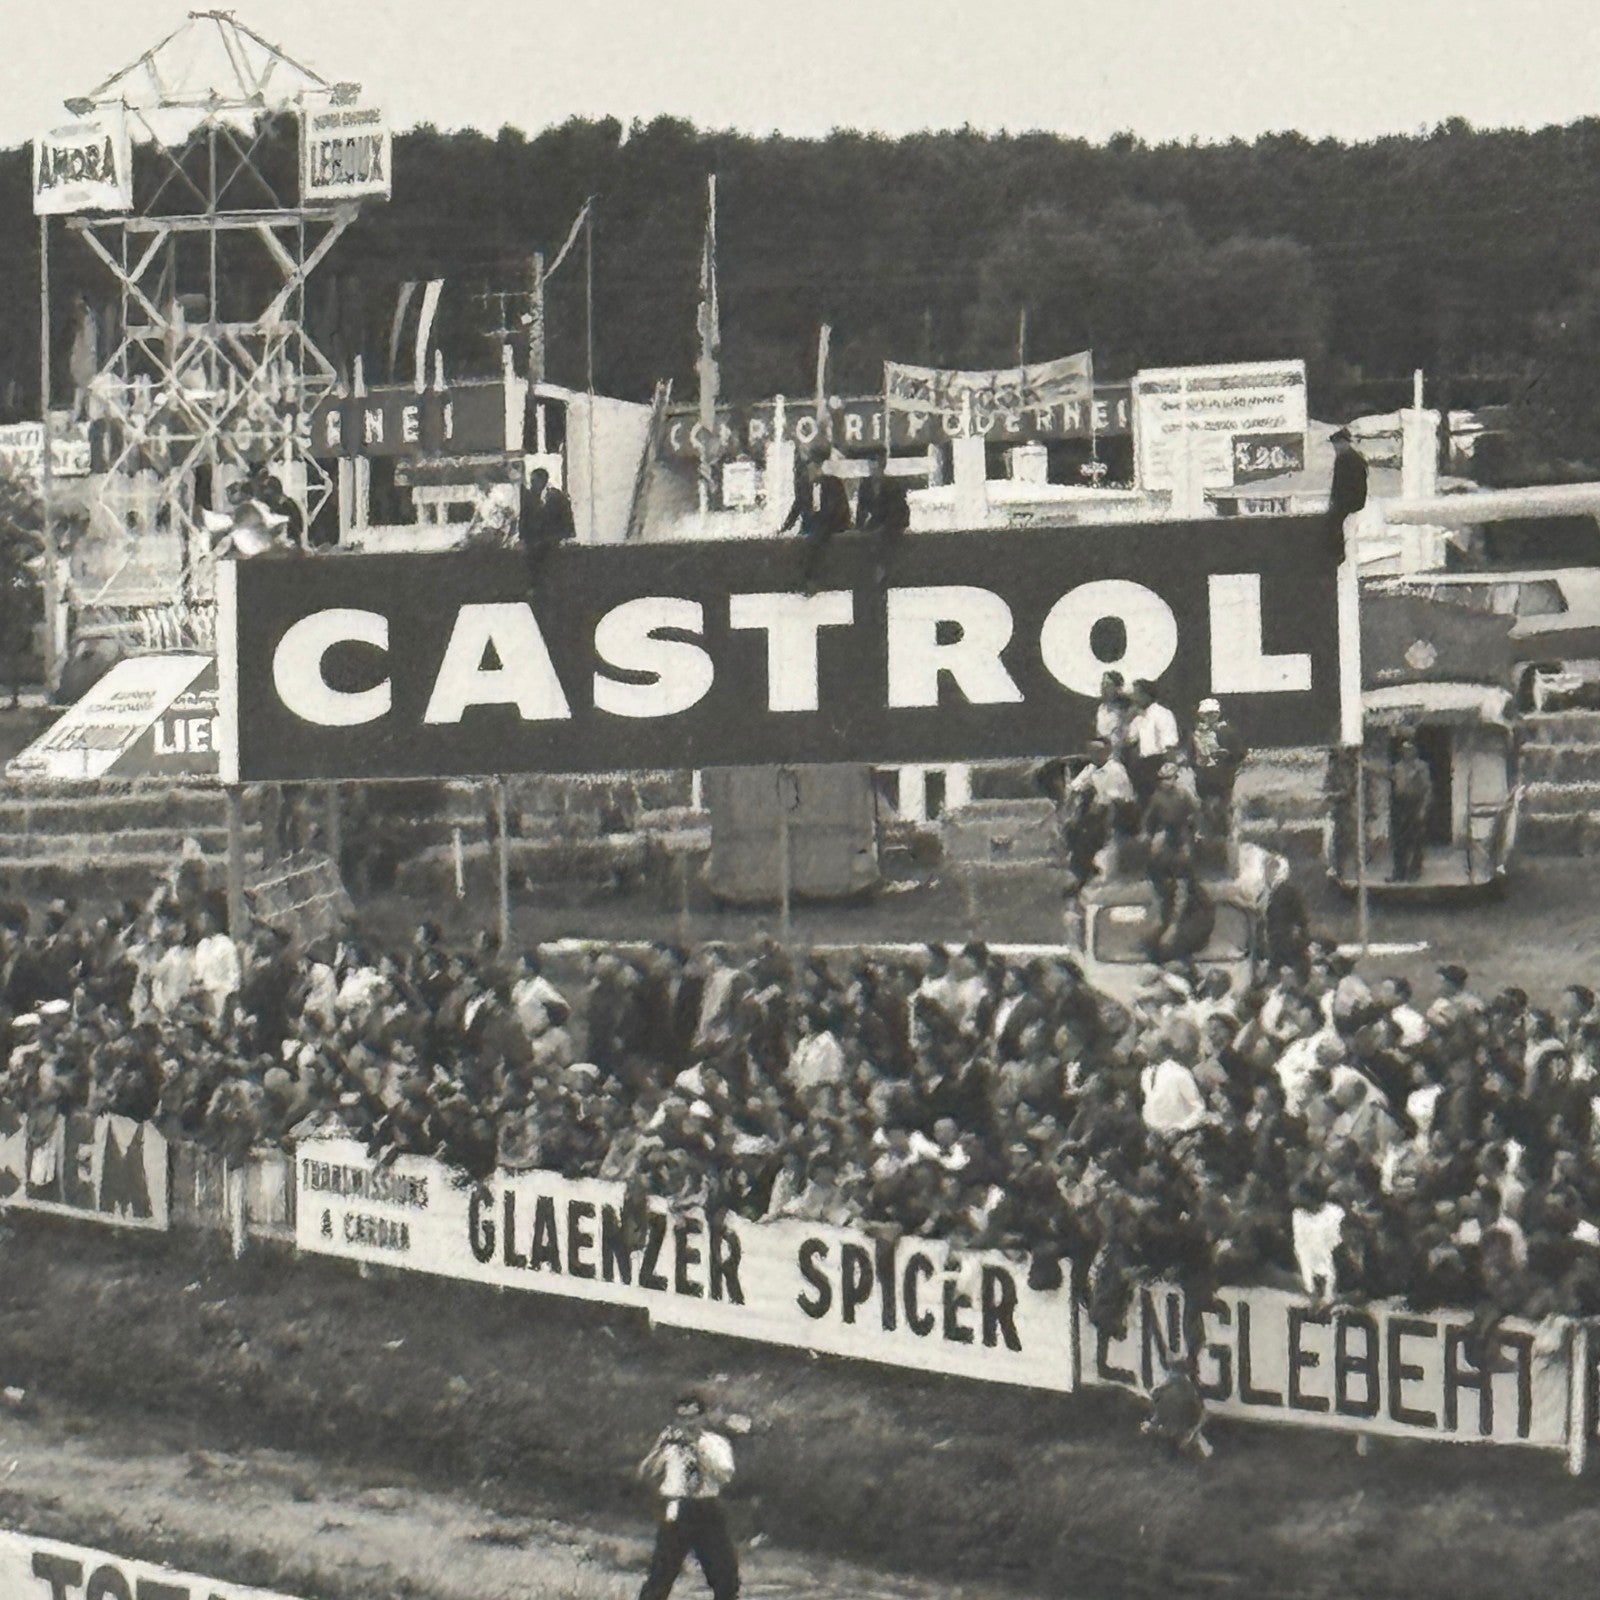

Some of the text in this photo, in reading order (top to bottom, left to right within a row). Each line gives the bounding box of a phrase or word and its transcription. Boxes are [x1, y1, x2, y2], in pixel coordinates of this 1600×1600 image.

[273, 573, 1312, 727] CASTROL
[467, 1185, 1023, 1352] GLAENZER SPICER
